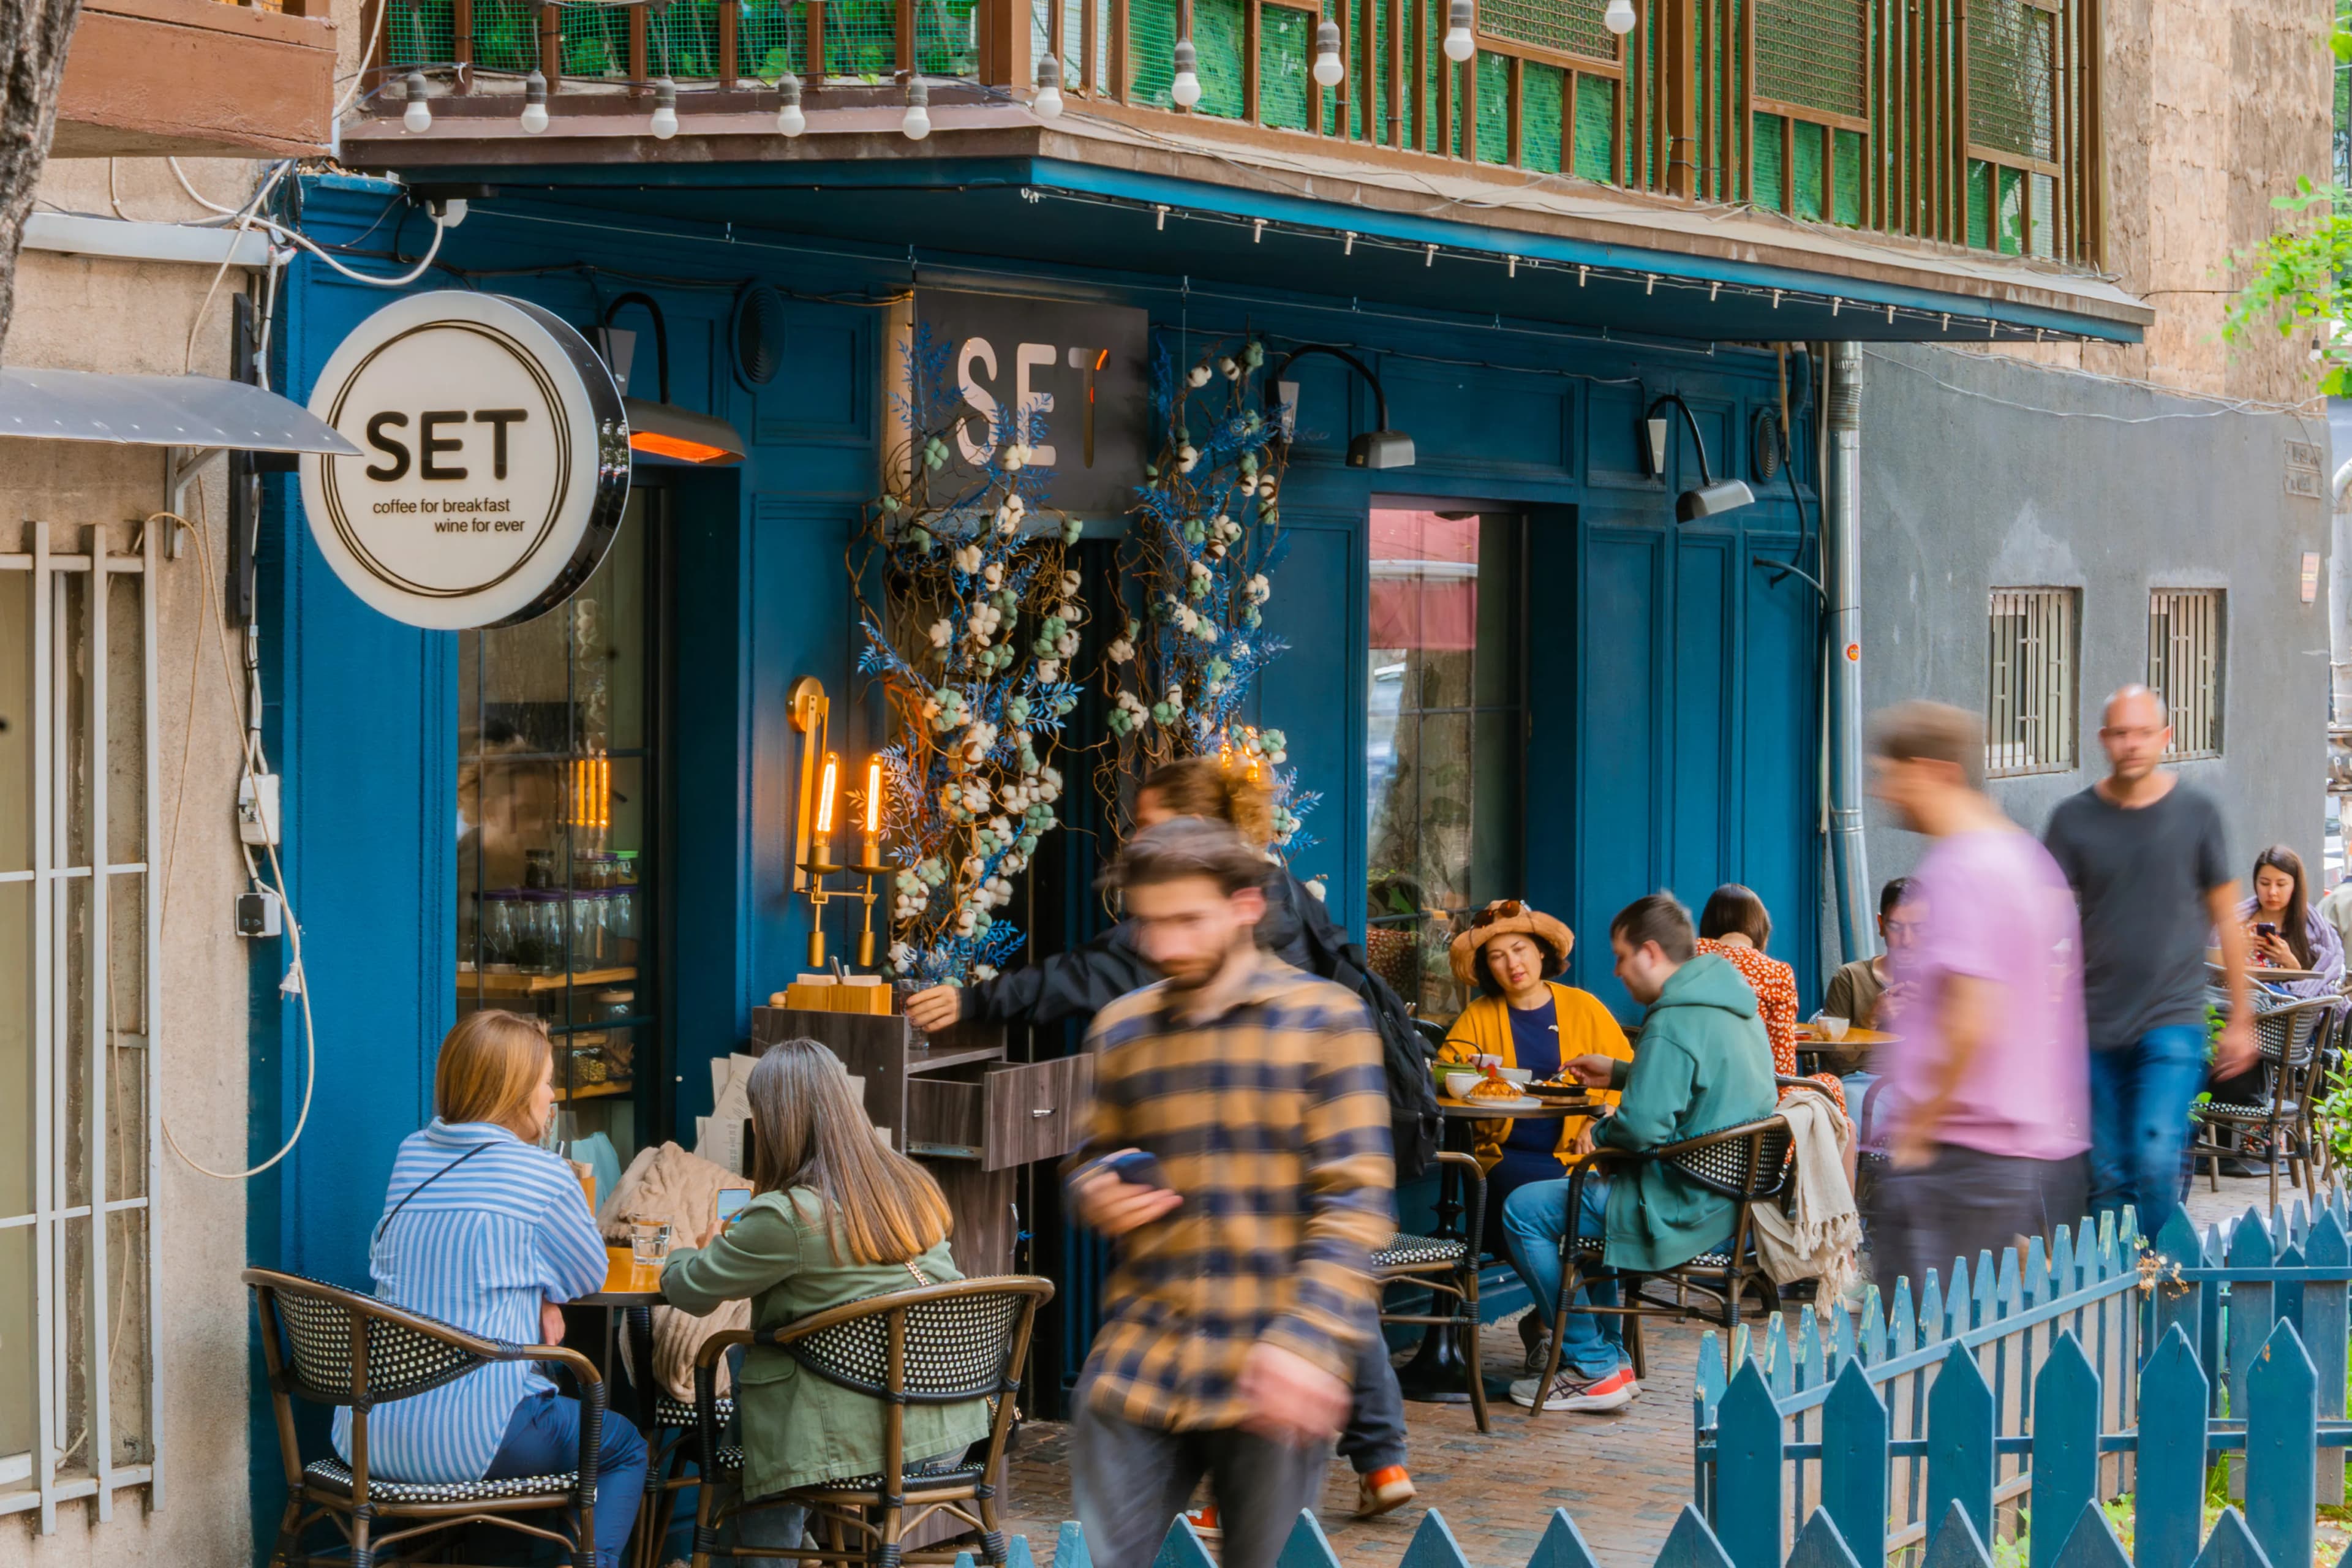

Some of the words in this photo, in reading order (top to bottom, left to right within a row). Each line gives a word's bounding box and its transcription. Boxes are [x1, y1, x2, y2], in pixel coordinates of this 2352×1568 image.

[956, 337, 1110, 469] SET
[366, 409, 529, 482] SET
[372, 499, 417, 514] coffee
[421, 498, 439, 513] for
[442, 497, 511, 513] breakfast
[434, 518, 469, 532] wine
[472, 518, 491, 532] for
[494, 520, 526, 532] ever
